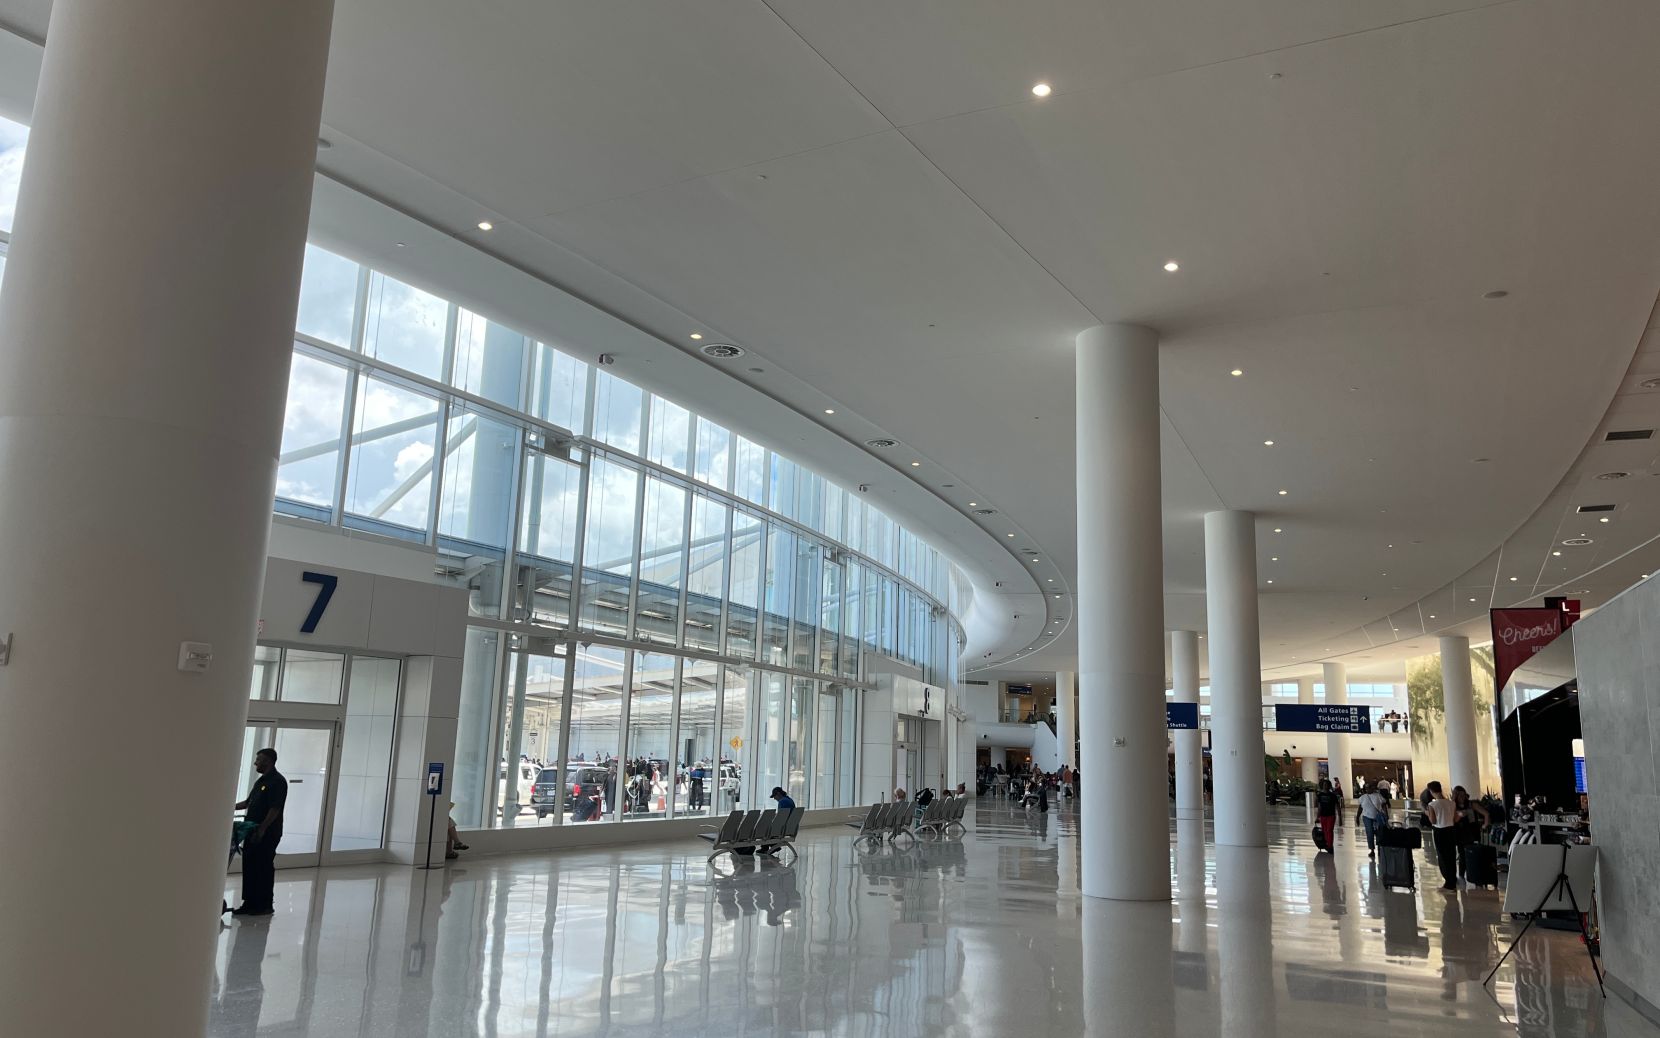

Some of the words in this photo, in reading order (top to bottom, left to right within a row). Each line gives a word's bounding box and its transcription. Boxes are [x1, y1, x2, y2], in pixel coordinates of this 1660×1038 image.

[300, 571, 338, 633] 7
[1498, 618, 1557, 646] Cheers!
[1318, 715, 1349, 723] Ticketing
